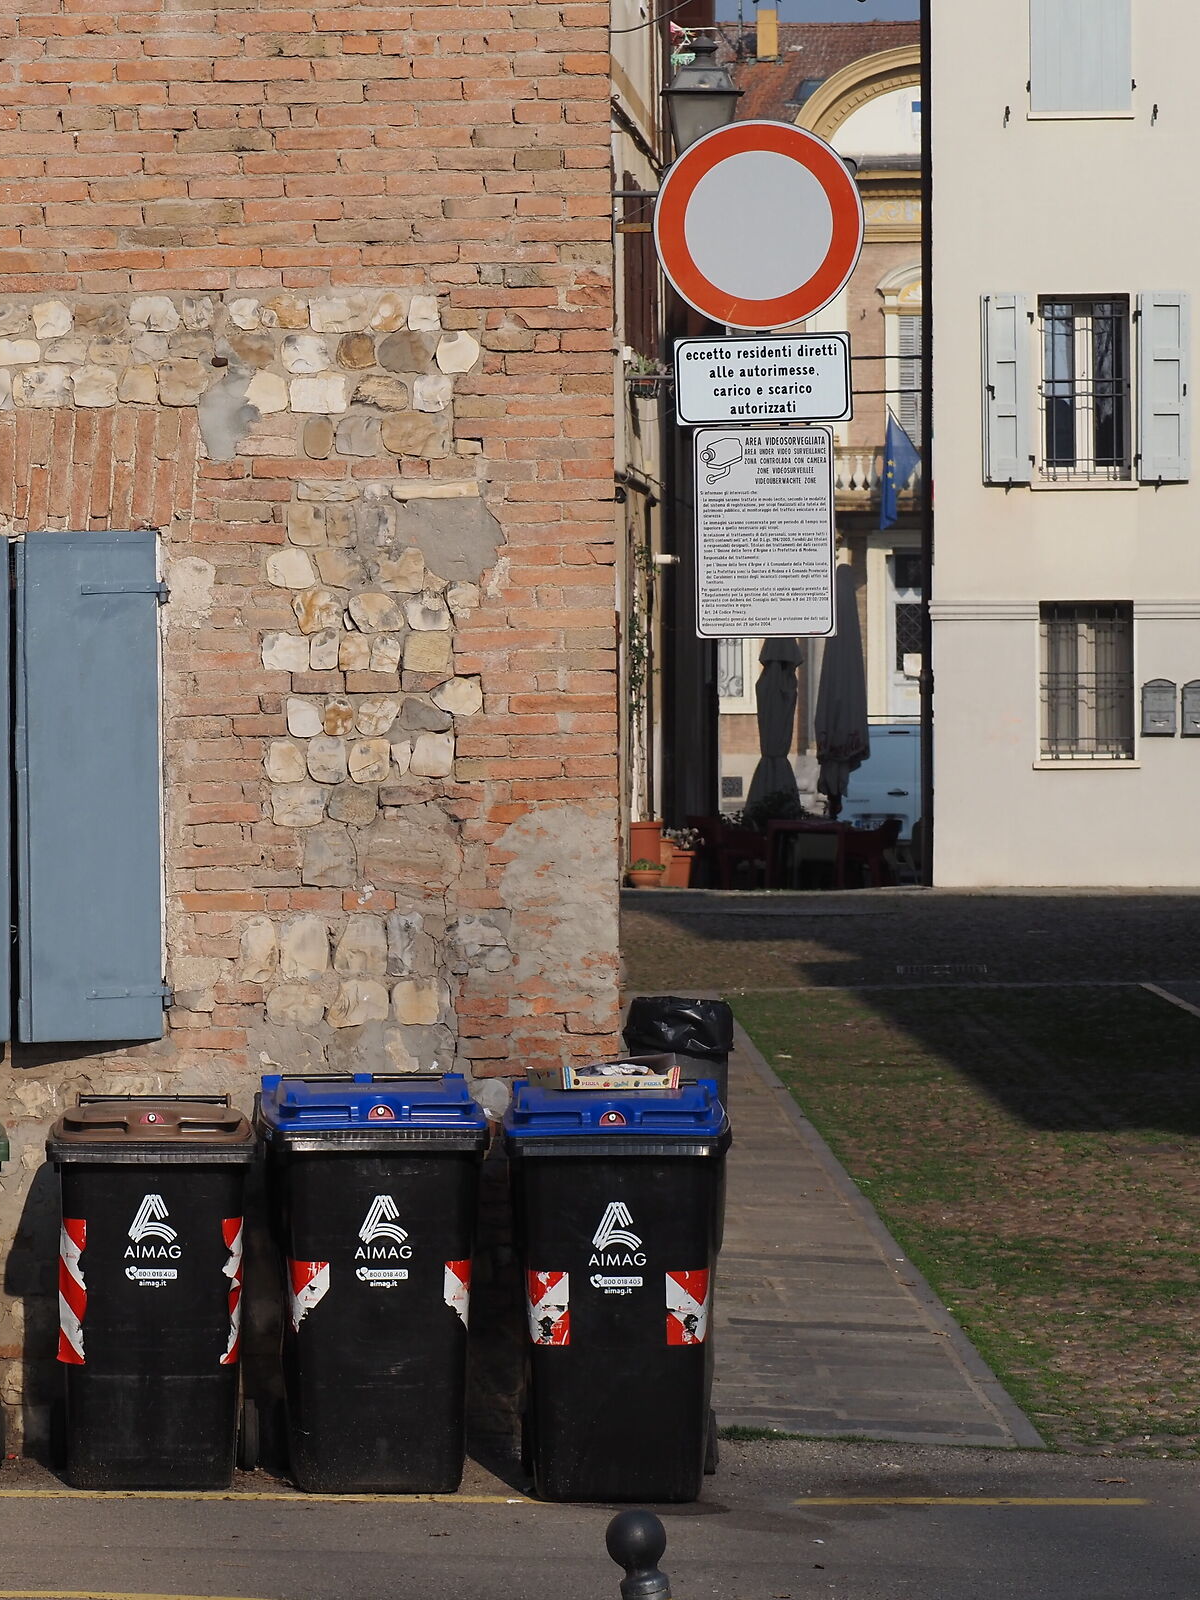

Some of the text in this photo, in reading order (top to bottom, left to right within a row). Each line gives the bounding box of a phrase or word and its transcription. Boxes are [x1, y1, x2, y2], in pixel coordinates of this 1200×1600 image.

[686, 344, 836, 360] eccetto residenti diretti
[710, 366, 734, 378] alle
[714, 382, 812, 396] carico e scarico
[731, 401, 795, 414] autorizzati
[745, 436, 825, 445] AREA VIDEOSORVEGLIATA
[124, 1245, 182, 1259] AIMAG
[354, 1245, 413, 1259] AIMAG
[588, 1253, 647, 1266] AIMAG
[139, 1280, 167, 1288] aimag.it
[369, 1280, 398, 1288] aimag.it
[604, 1287, 633, 1295] aimag.it
